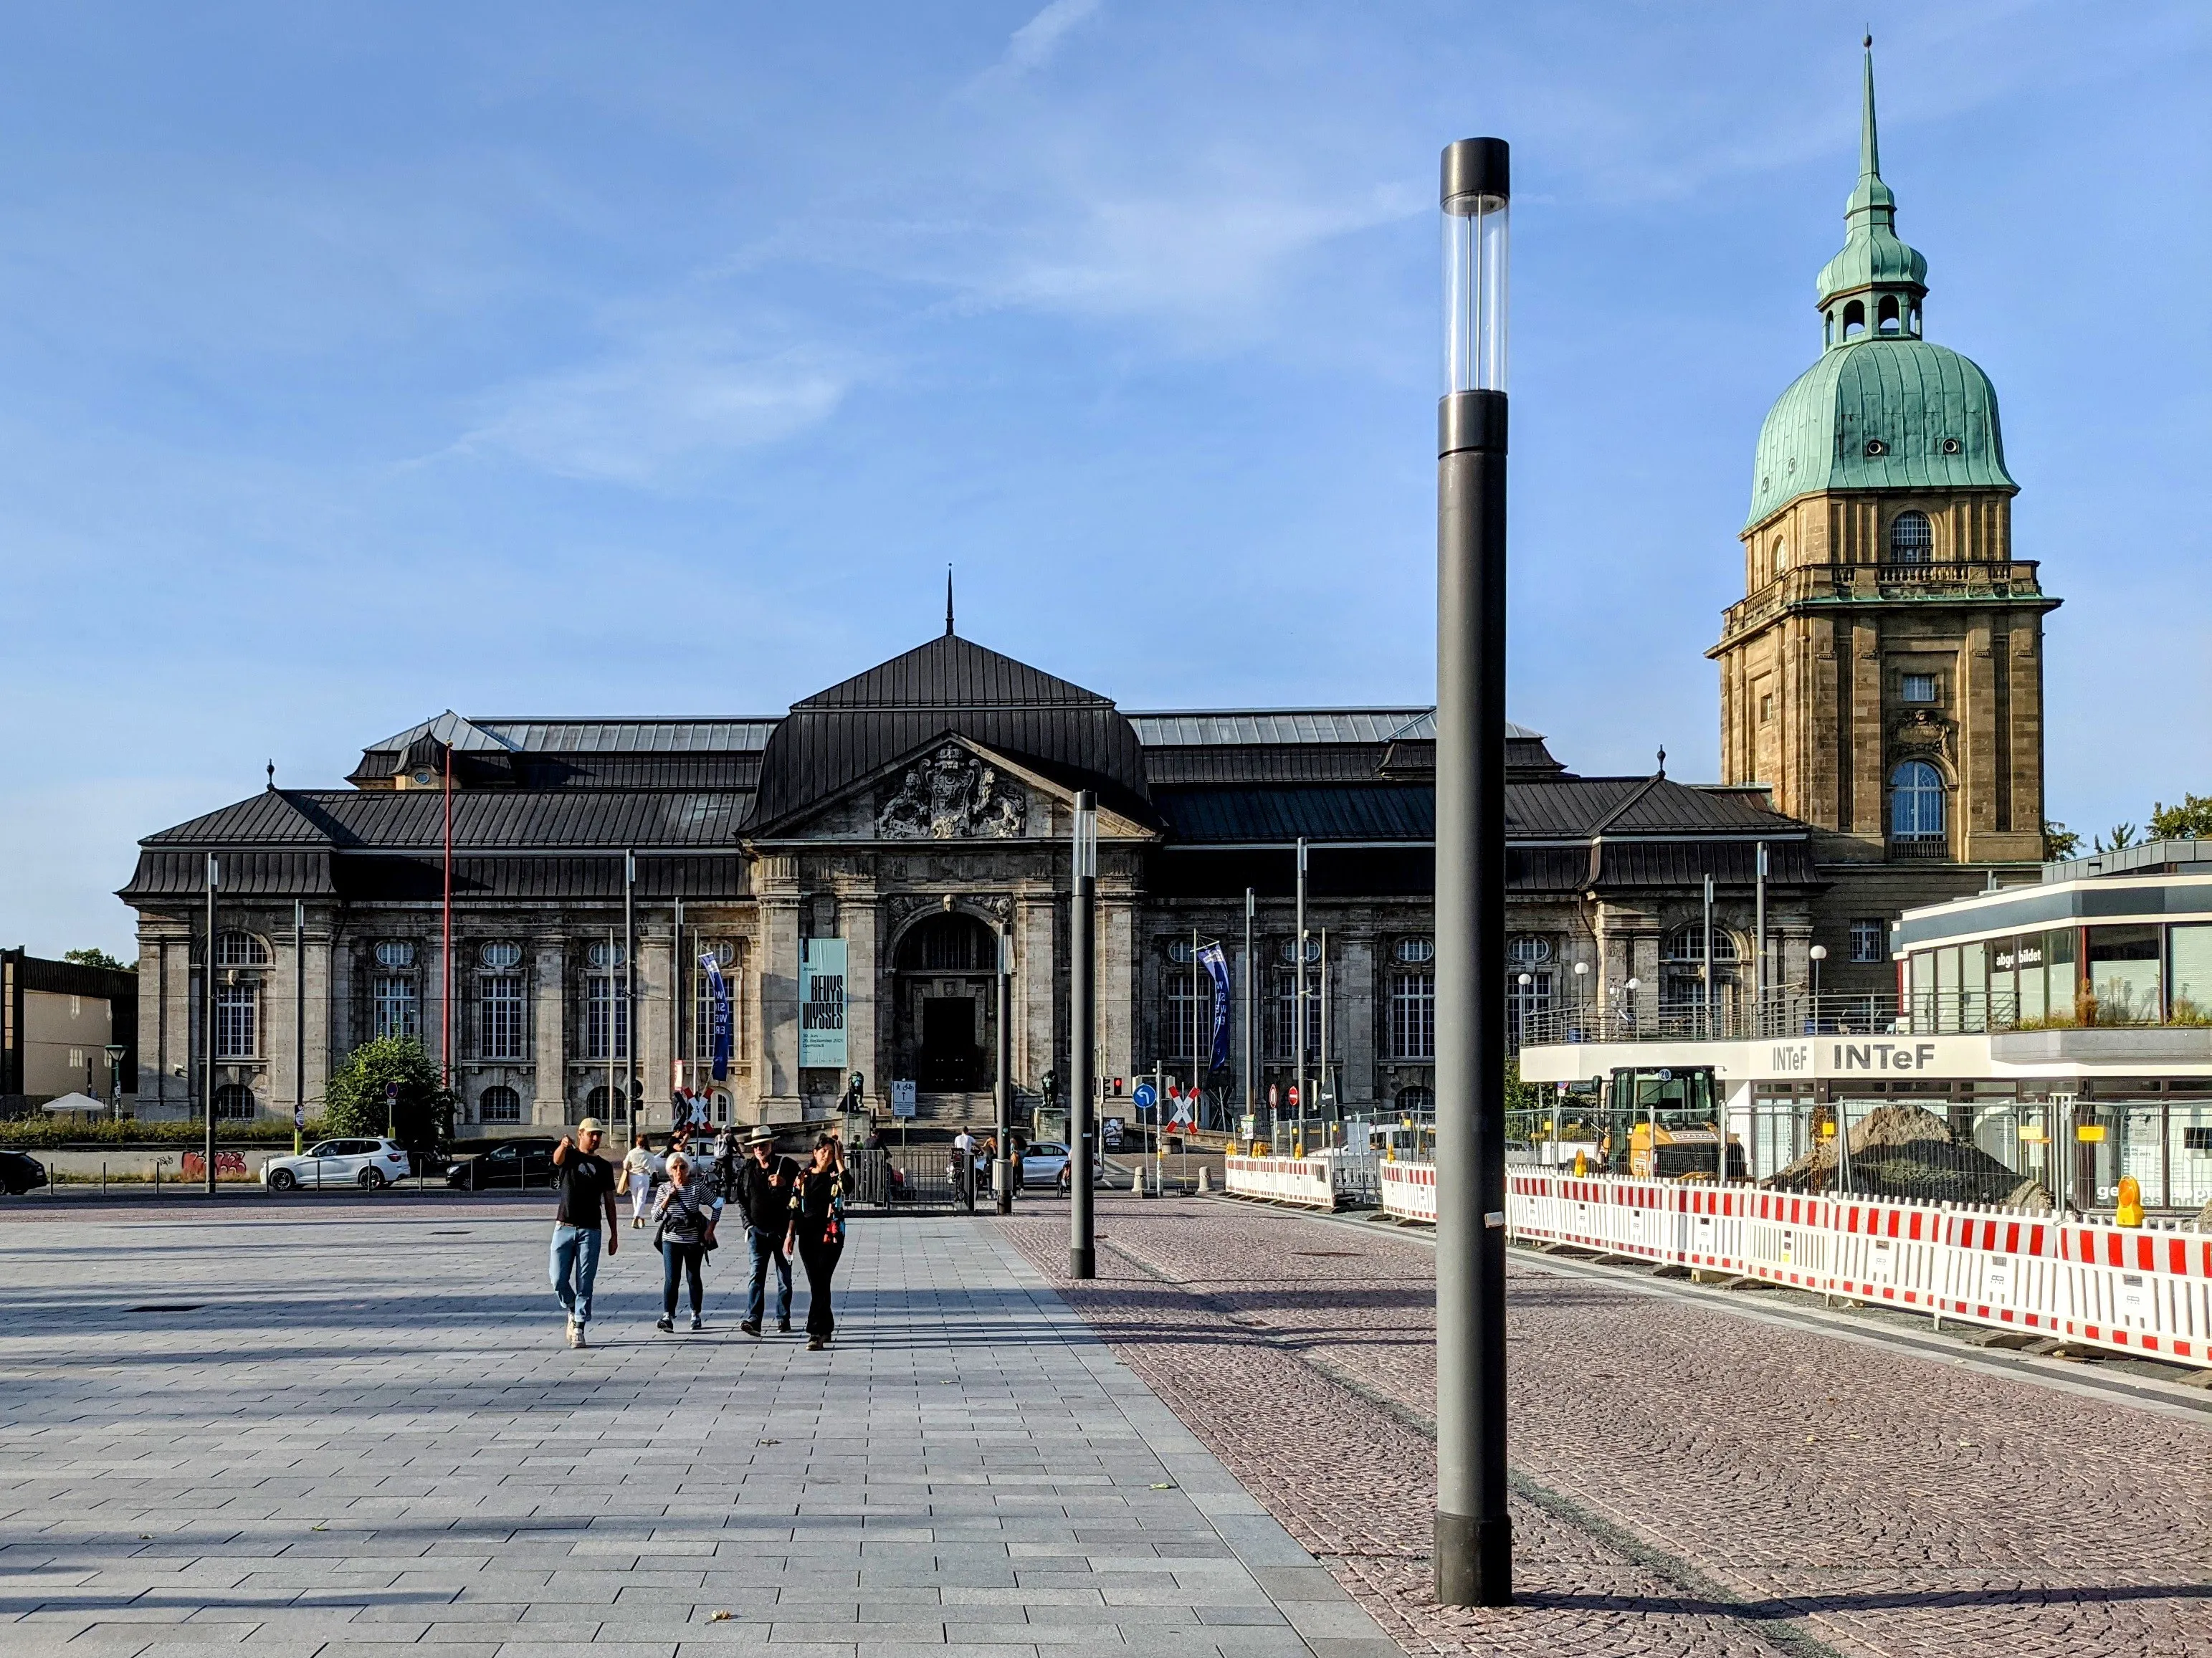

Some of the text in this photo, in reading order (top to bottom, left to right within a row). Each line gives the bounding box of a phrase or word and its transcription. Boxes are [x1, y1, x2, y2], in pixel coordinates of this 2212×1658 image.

[811, 975, 843, 1002] BEUYS
[803, 1002, 843, 1029] ULYSSES
[1773, 1046, 1807, 1071] INTeF
[1834, 1044, 1935, 1069] INTeF
[1660, 1071, 1669, 1080] 20
